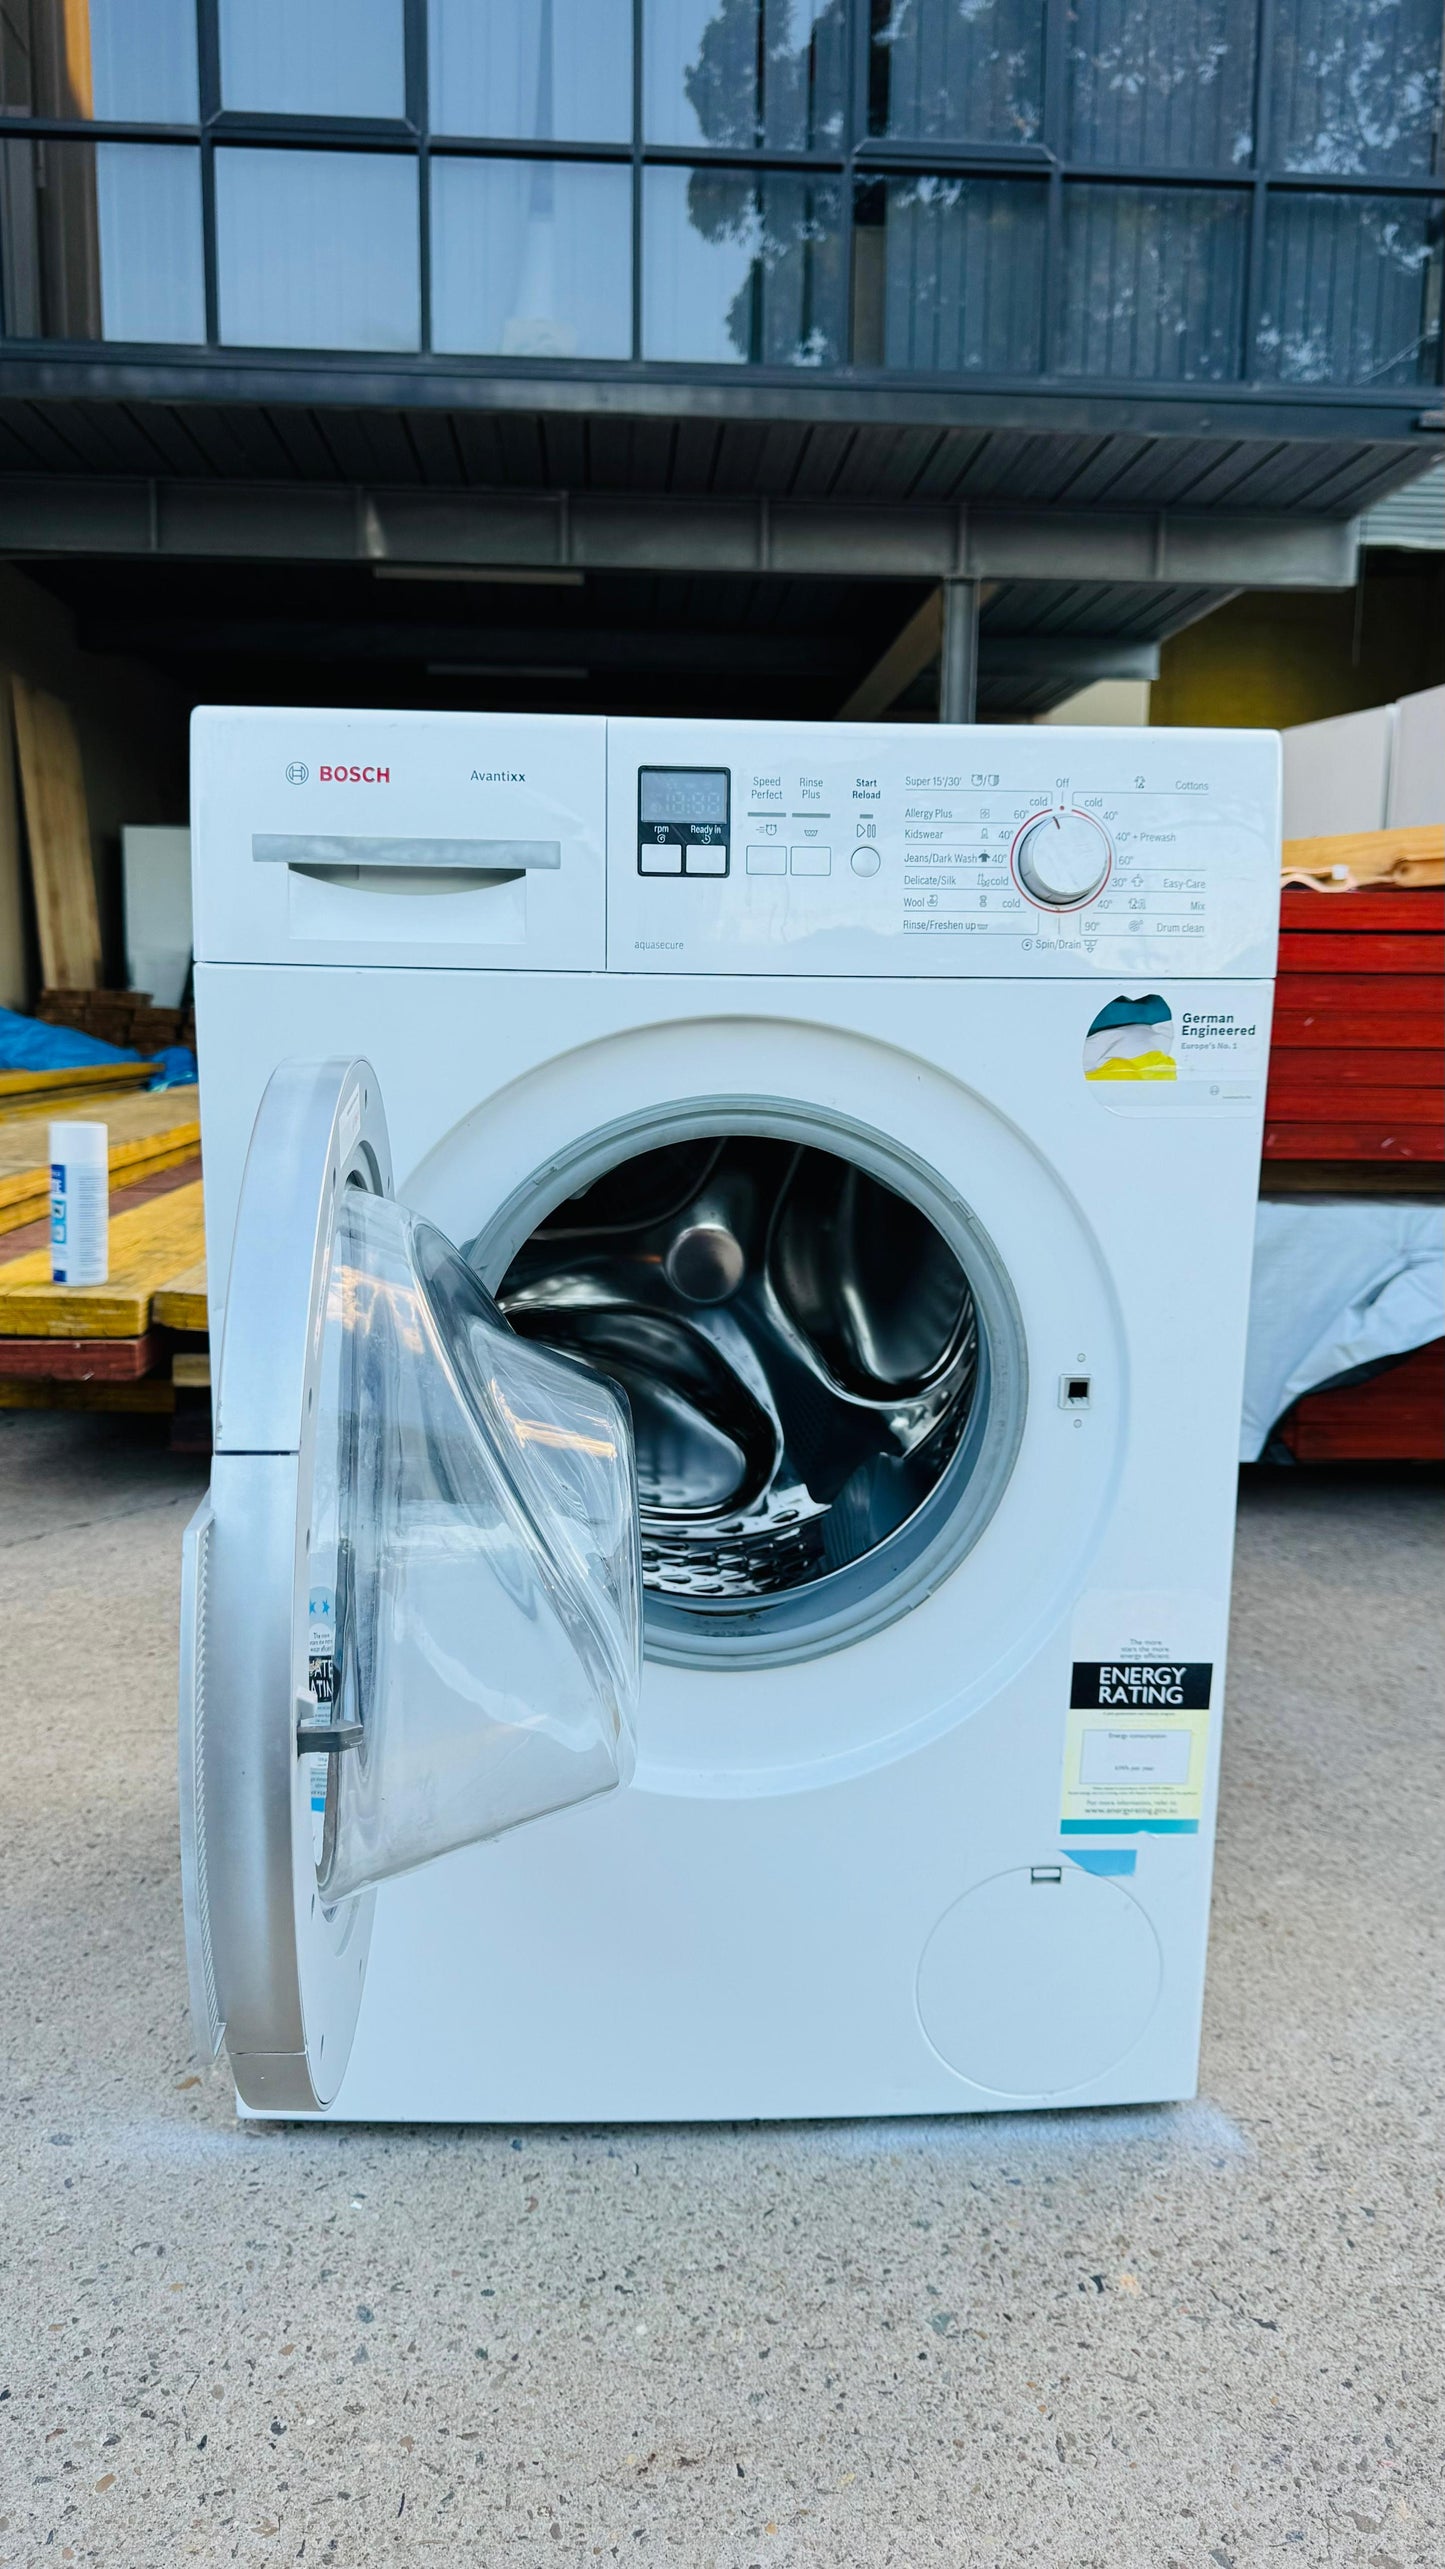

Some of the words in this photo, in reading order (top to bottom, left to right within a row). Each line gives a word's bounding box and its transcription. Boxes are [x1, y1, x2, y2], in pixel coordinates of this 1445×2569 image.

[319, 765, 390, 783] BOSCH
[470, 769, 526, 783] Avantixx
[753, 777, 781, 788] Speed
[799, 777, 824, 788] Rinse
[856, 778, 877, 788] Start
[905, 776, 930, 788] Super
[1056, 778, 1070, 788] Off
[1175, 780, 1209, 791] Cottons
[751, 789, 783, 800] Perfect
[802, 790, 820, 800] Plus
[852, 790, 881, 800] Reload
[1029, 796, 1048, 806] cold
[1084, 798, 1103, 808] cold
[904, 808, 933, 820] Allergy
[934, 808, 952, 818] Plus
[1014, 810, 1029, 820] 60°
[1102, 810, 1118, 820] 40°
[654, 824, 669, 835] rpm
[690, 824, 712, 835] Ready
[714, 825, 722, 834] in
[904, 829, 943, 840] Kidswear
[998, 830, 1014, 840] 40°
[1140, 832, 1176, 842] Prewash
[904, 853, 952, 864] Jeans/Dark
[954, 854, 978, 864] Wash
[1118, 856, 1134, 866] 60°
[904, 875, 956, 886] Delicate/Silk
[990, 876, 1009, 886] cold
[904, 898, 925, 908] Wool
[1002, 898, 1020, 908] cold
[1190, 901, 1205, 911] Mix
[903, 920, 964, 930] Rinse/Freshen
[966, 922, 976, 932] up
[1156, 923, 1180, 932] Drum
[1182, 923, 1204, 932] clean
[634, 940, 684, 950] aquasecure
[1035, 939, 1081, 950] Spin/Drain
[1182, 1012, 1234, 1024] German
[1181, 1025, 1256, 1038] Engineered
[1181, 1042, 1216, 1052] Europe's
[1099, 1666, 1187, 1685] ENERGY
[1098, 1686, 1184, 1704] RATING
